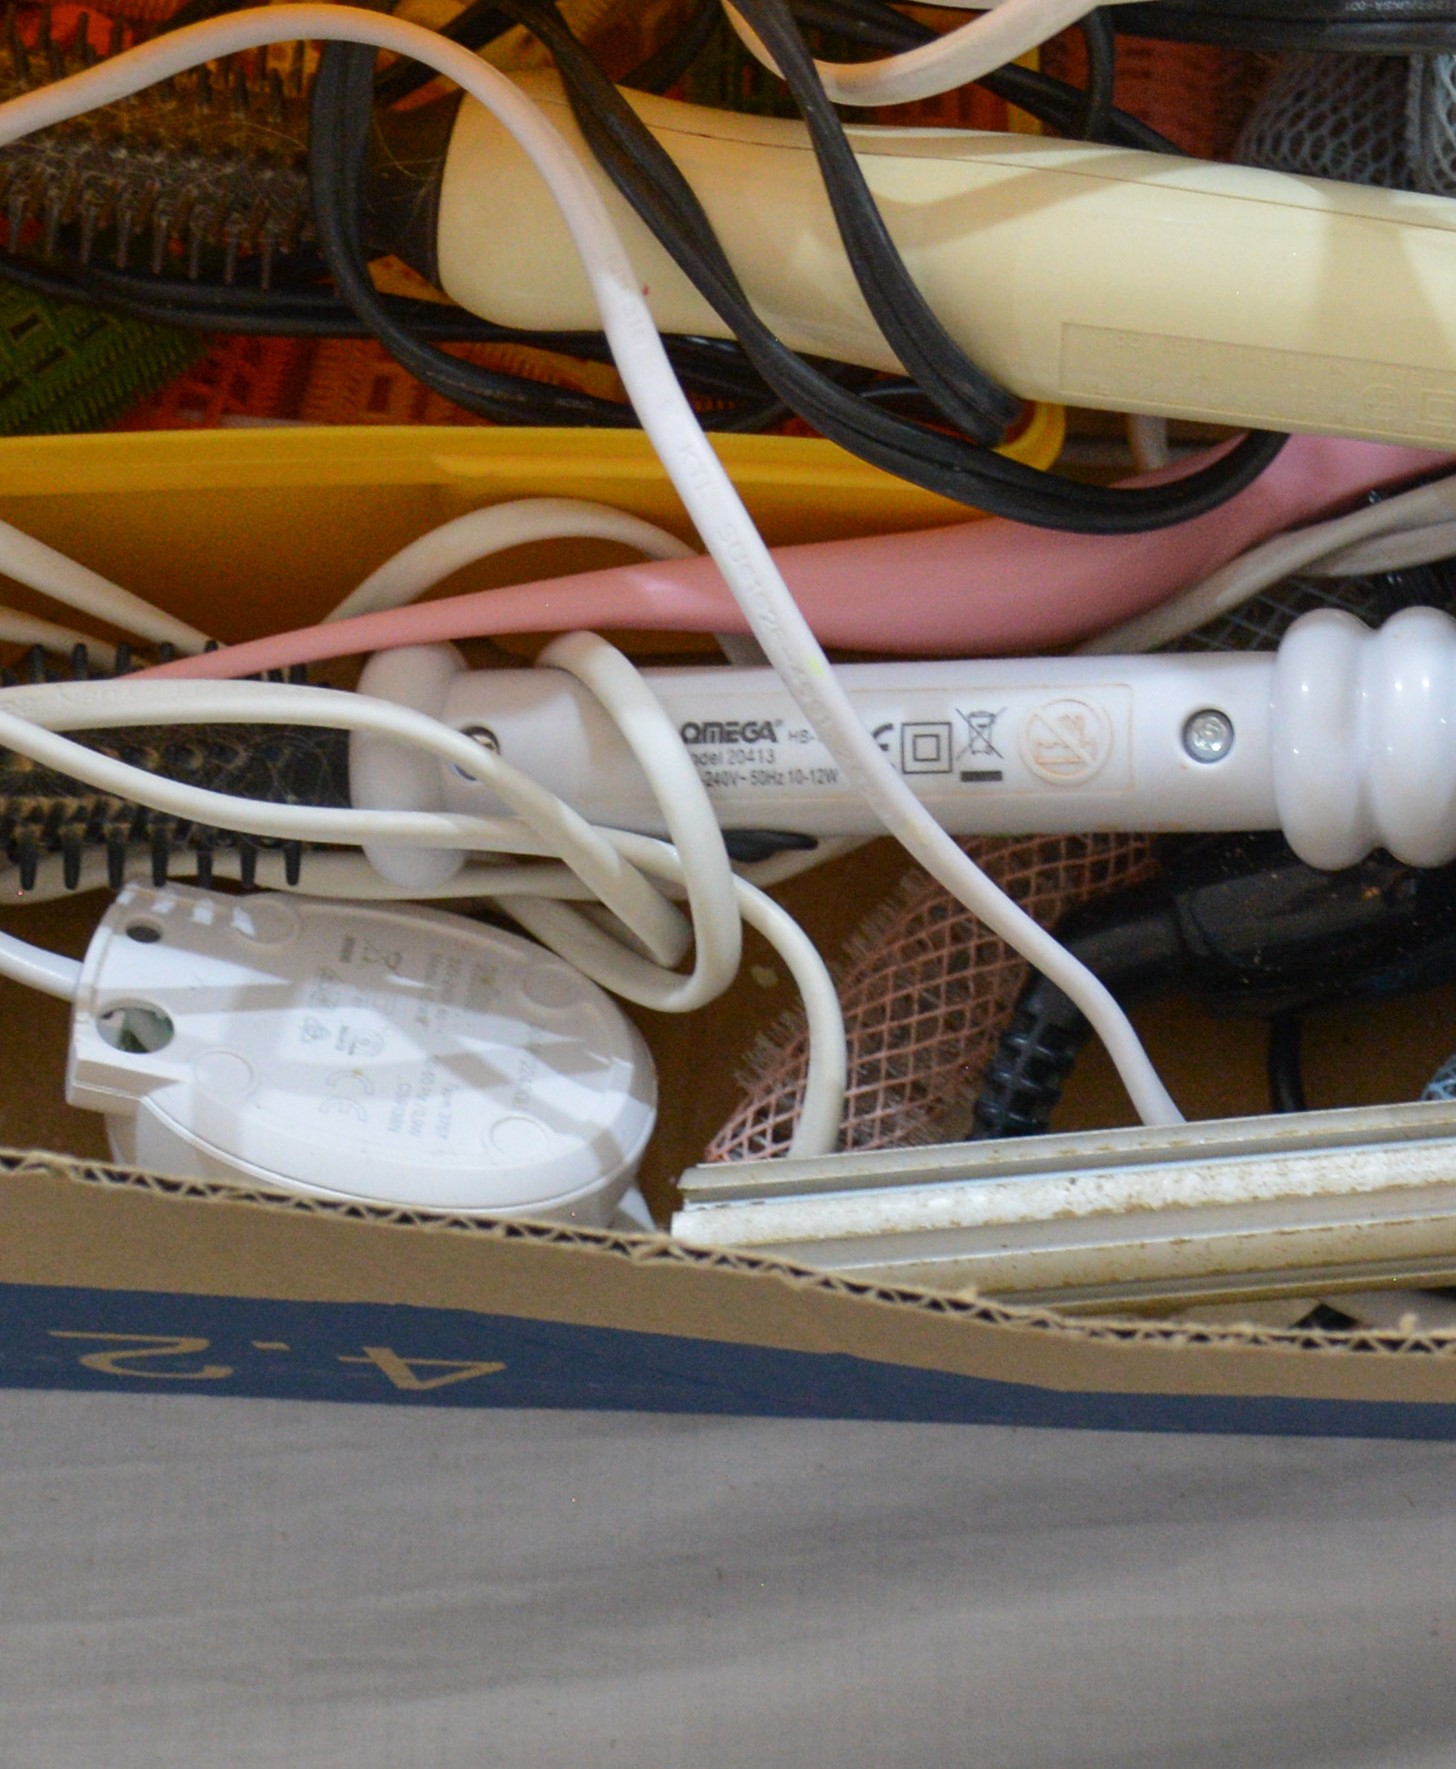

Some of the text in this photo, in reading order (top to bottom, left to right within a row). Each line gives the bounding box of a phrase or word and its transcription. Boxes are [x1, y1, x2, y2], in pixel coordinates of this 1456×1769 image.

[680, 720, 779, 745] OMEGA
[691, 748, 776, 766] odel 20413
[46, 1328, 508, 1393] 4.2
